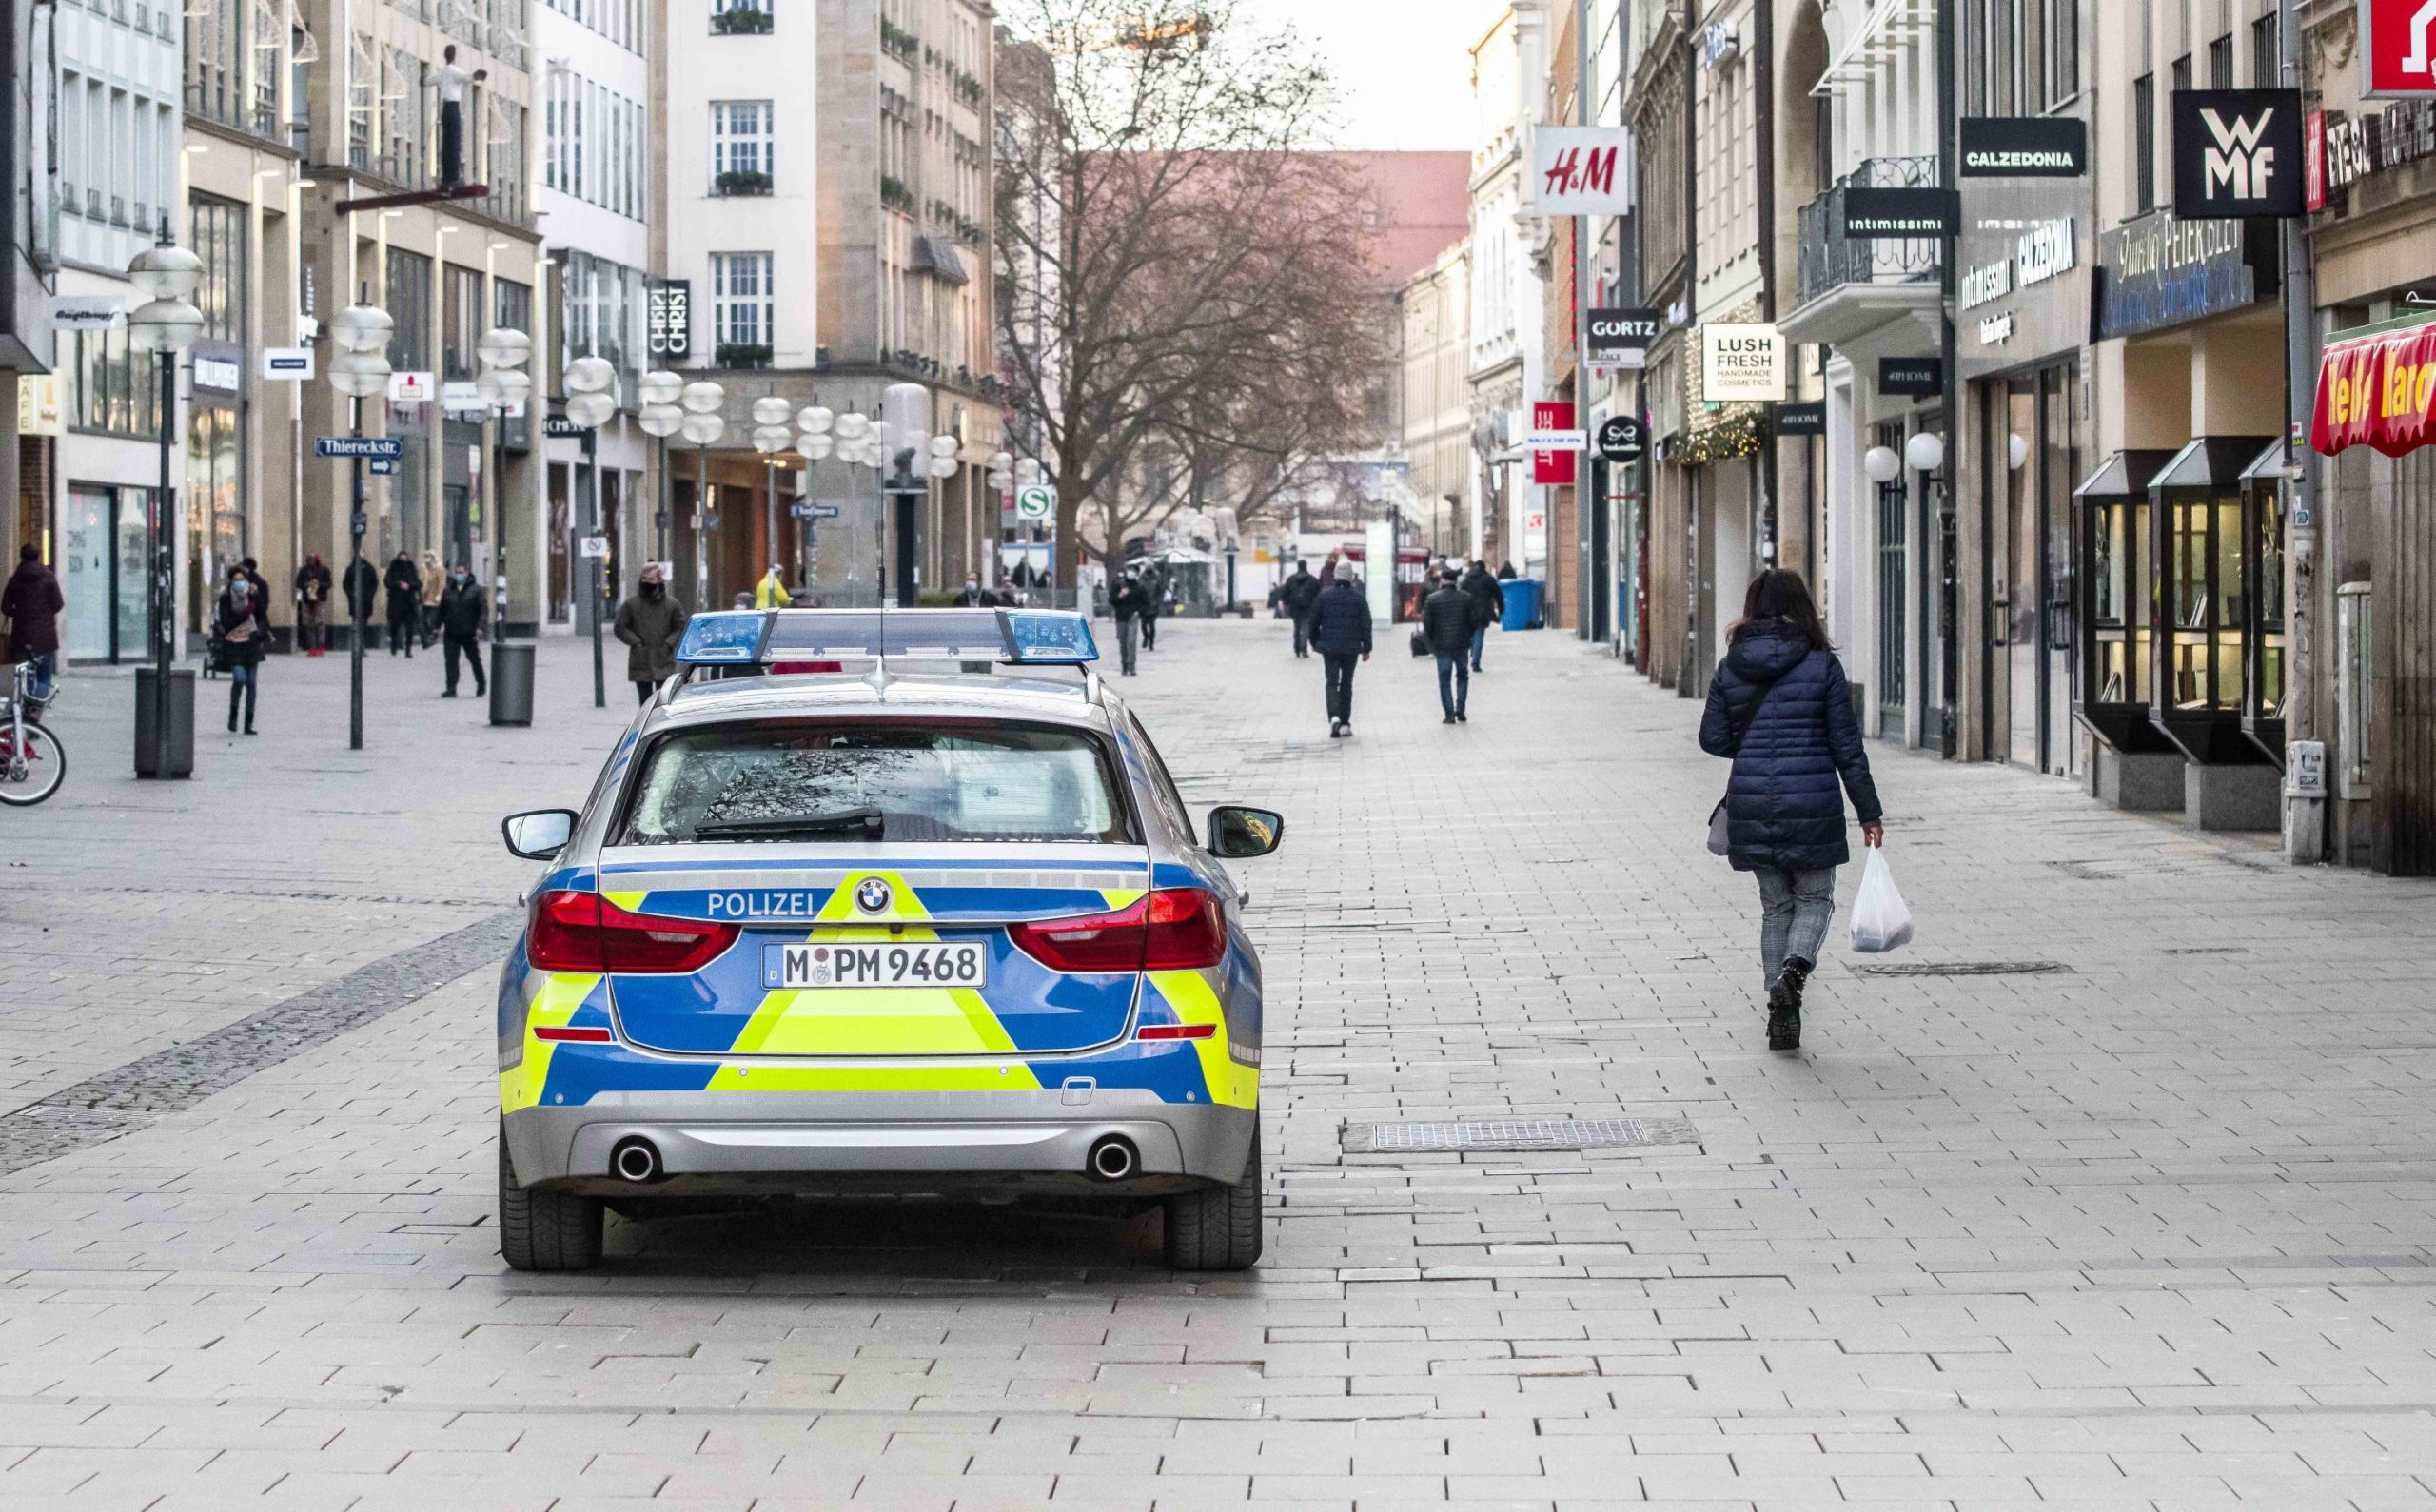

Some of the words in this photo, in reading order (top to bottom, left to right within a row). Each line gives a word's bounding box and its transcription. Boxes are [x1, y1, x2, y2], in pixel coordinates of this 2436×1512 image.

[1967, 152, 2073, 167] CALZEDONIA
[2199, 108, 2274, 200] WMF
[1545, 146, 1618, 196] H&M
[1849, 218, 1942, 230] intimissimi
[668, 288, 687, 353] CHRIST
[1718, 338, 1771, 352] LUSH
[1718, 355, 1771, 367] FRESH
[1717, 369, 1770, 378] HANDMADE
[324, 440, 397, 454] Thiereckstr.
[708, 893, 813, 916] POLIZEI
[769, 970, 777, 981] D
[835, 948, 880, 982] PM
[888, 948, 977, 981] 9468
